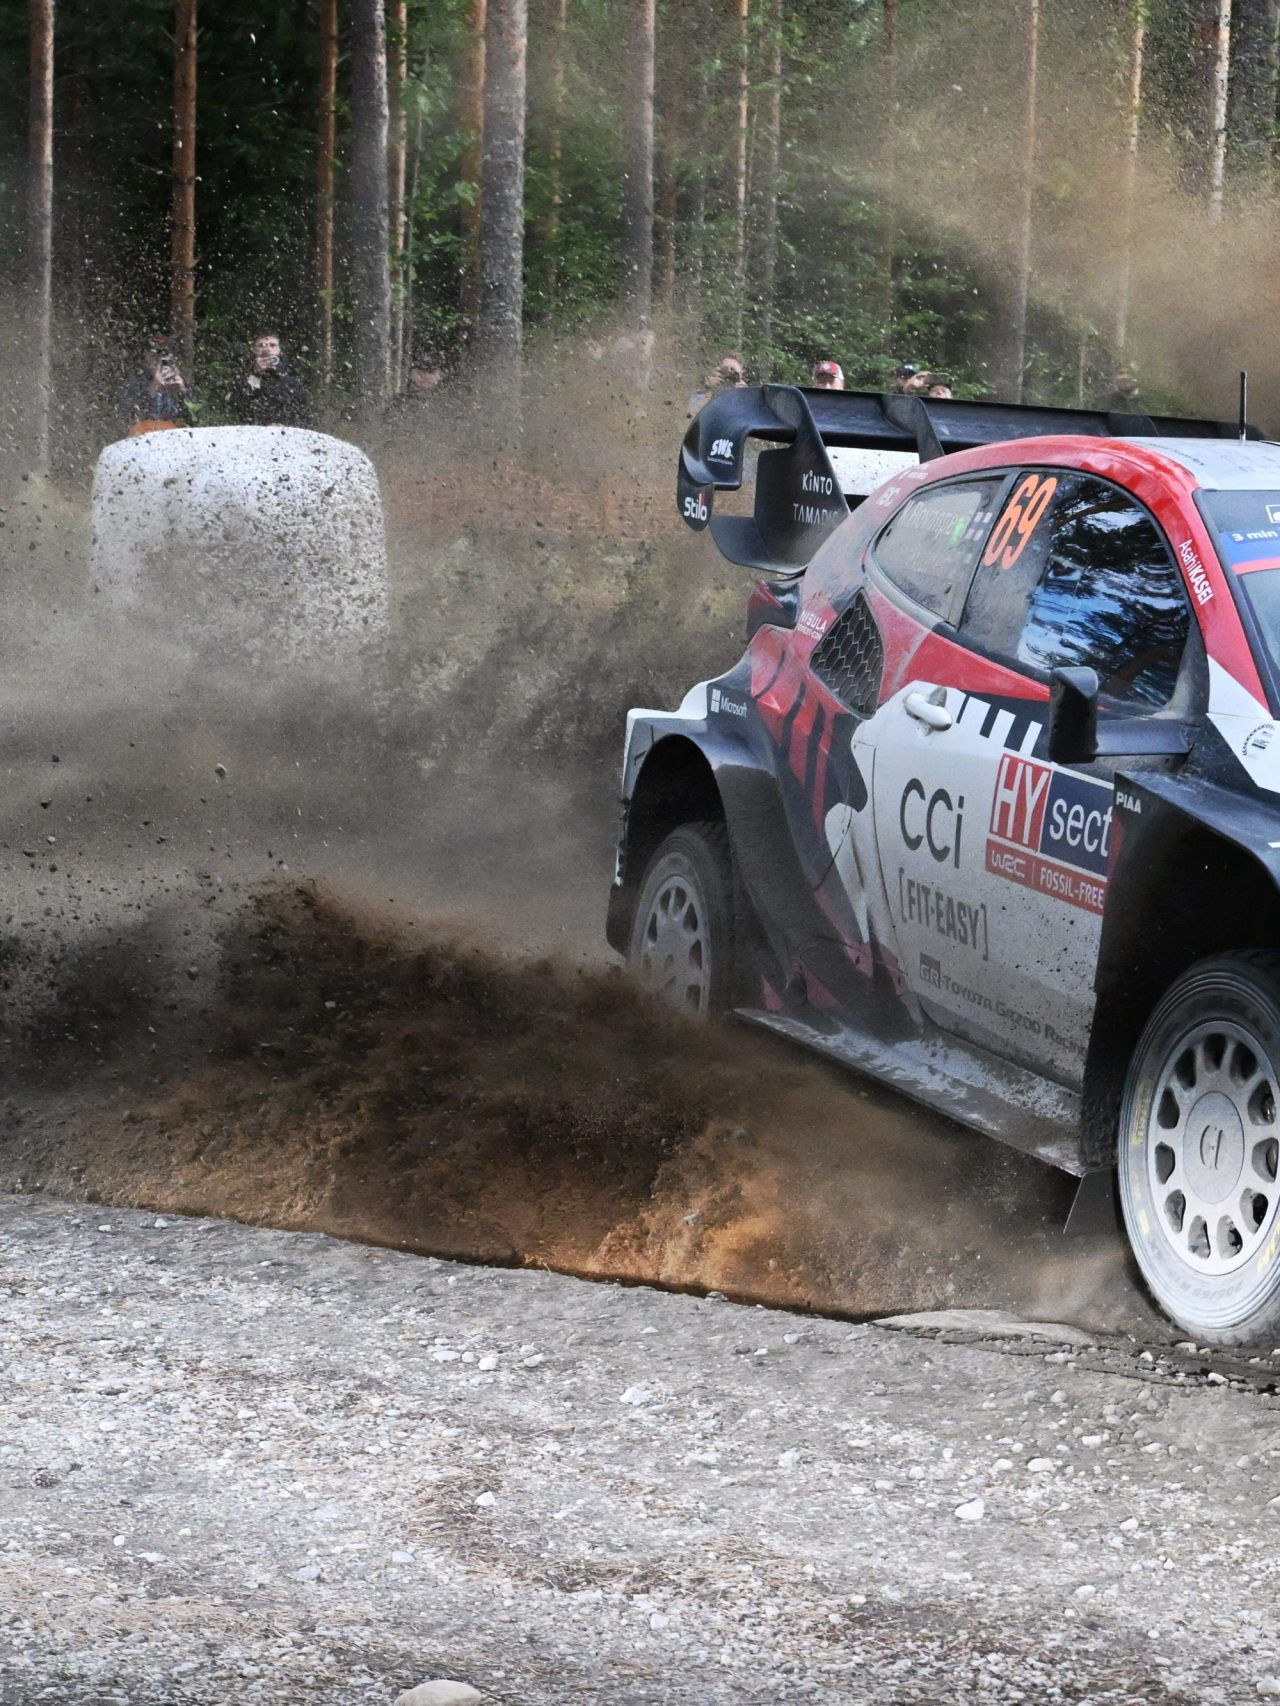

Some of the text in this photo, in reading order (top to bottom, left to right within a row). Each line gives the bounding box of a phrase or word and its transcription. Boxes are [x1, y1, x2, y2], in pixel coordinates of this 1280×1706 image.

[710, 438, 735, 459] SWS
[683, 494, 708, 521] Stilo
[984, 473, 1057, 570] 69
[1231, 529, 1279, 542] 3 min
[1179, 539, 1214, 605] AsahiKASEI
[720, 696, 748, 718] Microsoft
[992, 758, 1050, 845] HY
[1115, 792, 1142, 814] PIAA
[1040, 867, 1105, 910] FOSSIL-FREE
